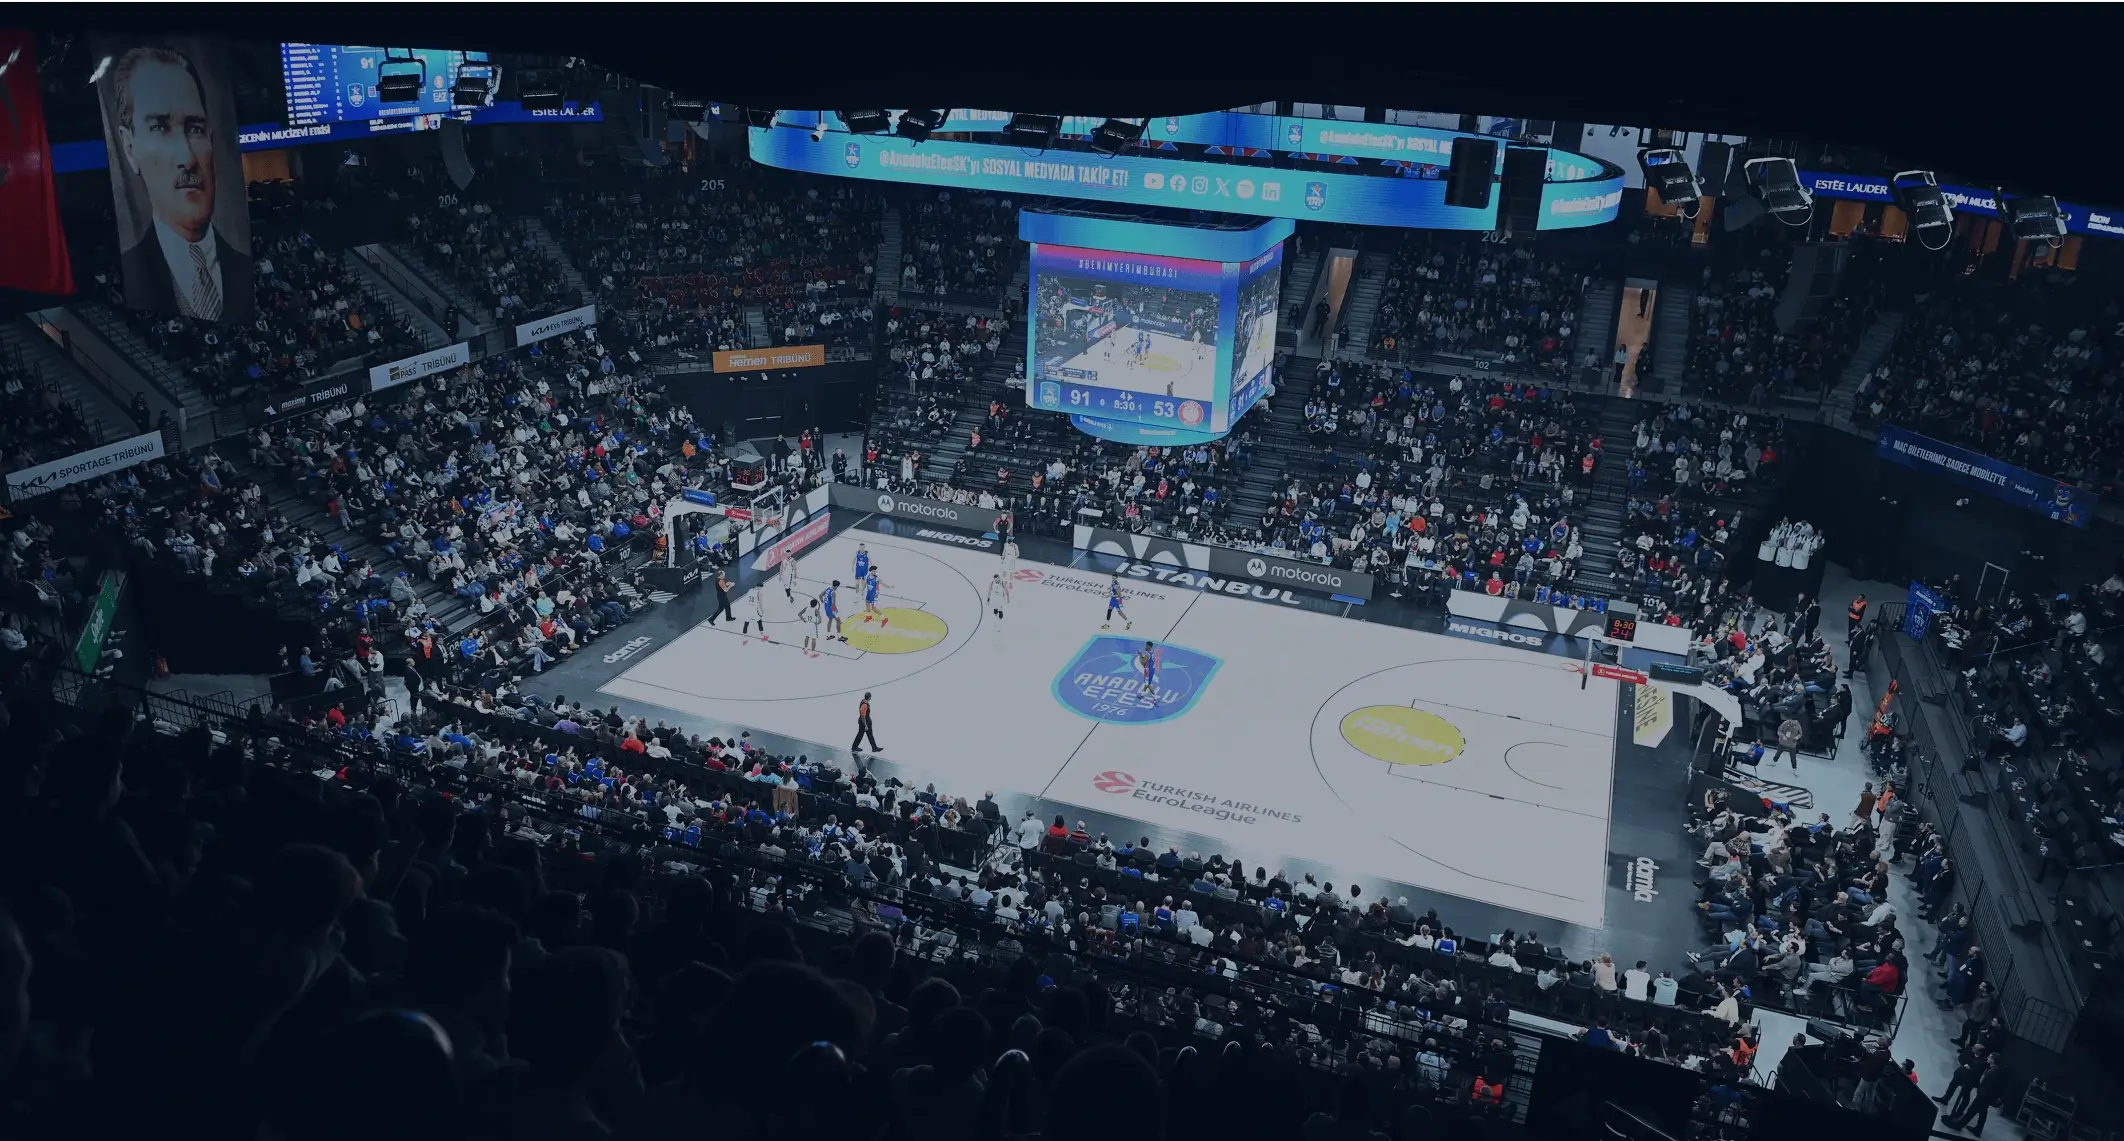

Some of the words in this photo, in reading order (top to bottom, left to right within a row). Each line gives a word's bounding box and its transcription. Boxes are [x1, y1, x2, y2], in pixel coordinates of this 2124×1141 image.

[360, 57, 374, 69] 91
[982, 158, 1022, 177] SOSYAL
[1024, 163, 1075, 182] MEDYADA
[1078, 165, 1109, 185] TAKİP
[1112, 170, 1129, 187] ET!
[701, 179, 725, 191] 205
[1846, 182, 1888, 195] LAUDER
[438, 193, 458, 208] 206
[400, 368, 417, 379] PASS
[422, 354, 457, 371] TRİBÜNÜ
[1475, 360, 1490, 370] 102
[310, 383, 348, 403] TRİBÜNÜ
[1070, 389, 1090, 407] 91
[1100, 398, 1106, 406] 0
[1119, 392, 1126, 400] 4
[1153, 400, 1175, 418] 53
[1113, 400, 1136, 411] 8:30
[21, 472, 57, 490] KIA
[59, 455, 111, 478] SPORTAGE
[112, 441, 154, 462] TRİBÜNÜ
[1893, 439, 1908, 454] MAÇ
[1907, 444, 1947, 466] BİLETLERİMİZ
[1945, 457, 1971, 474] SADECE
[736, 474, 748, 485] 24
[898, 501, 958, 521] motorola
[915, 529, 994, 549] MIGROS
[620, 547, 631, 560] 107
[1049, 574, 1104, 589] TURKISH
[1115, 561, 1301, 605] ISTANBUL
[1271, 564, 1342, 588] motorola
[1041, 580, 1132, 601] EuroLeage
[1643, 597, 1660, 610] 101
[1448, 622, 1543, 647] MIGROS
[1610, 627, 1629, 640] 24
[1614, 619, 1635, 630] 8:30
[602, 636, 652, 664] damla
[1074, 673, 1180, 704] ANADLU
[1083, 686, 1156, 709] EFES
[1091, 702, 1129, 716] 1976
[1132, 789, 1257, 825] EuroLeague
[1141, 780, 1217, 804] TURKISH
[1221, 799, 1302, 823] AIRLINES
[1634, 856, 1660, 903] damla
